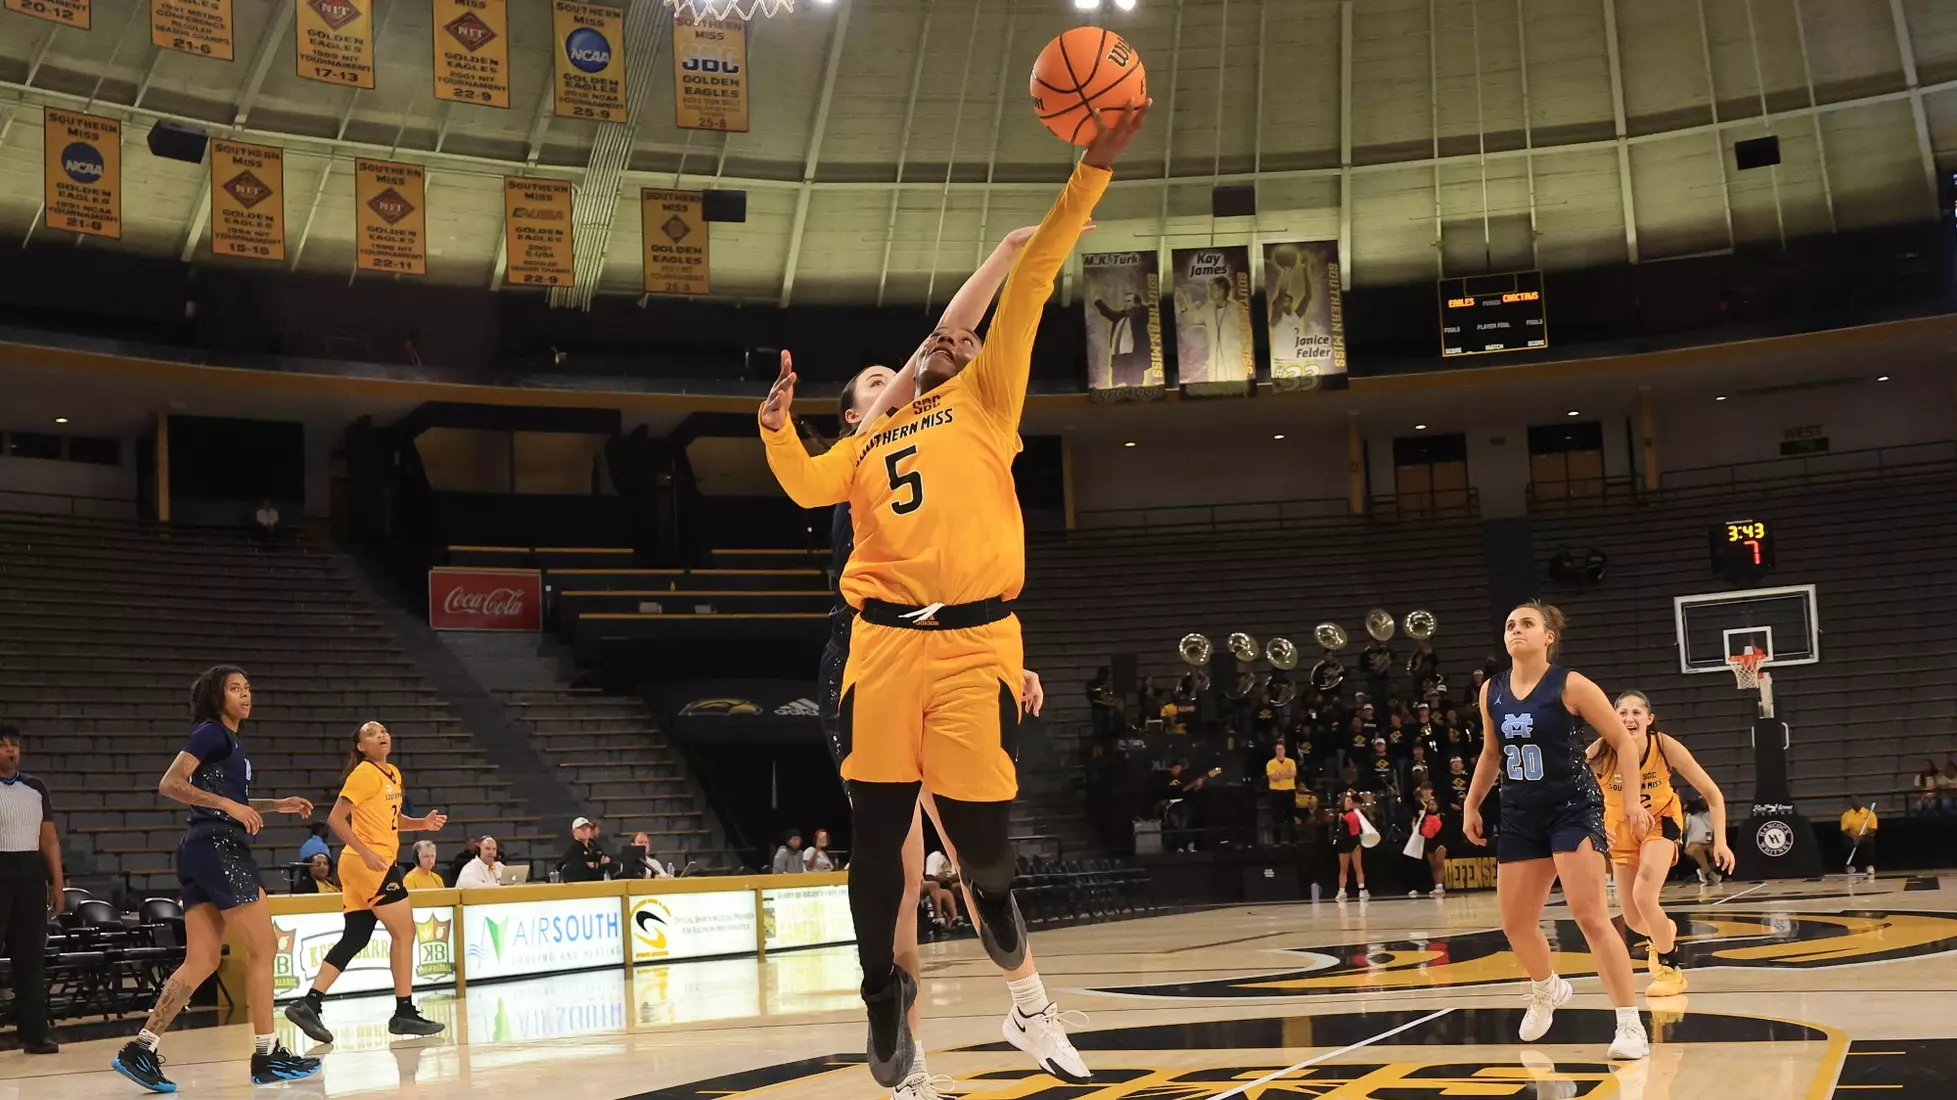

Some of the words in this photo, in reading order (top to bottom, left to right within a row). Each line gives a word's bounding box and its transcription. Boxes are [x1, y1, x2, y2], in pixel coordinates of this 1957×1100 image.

[21, 2, 74, 20] 20-12
[454, 0, 486, 9] MISS
[556, 2, 620, 18] SOUTHERN
[574, 16, 604, 28] MISS
[678, 18, 742, 30] SOUTHERN
[308, 28, 364, 46] GOLDEN
[458, 26, 484, 38] NIT
[695, 30, 724, 40] MISS
[173, 38, 211, 54] 21-6
[309, 38, 362, 52] EAGLES
[444, 52, 498, 66] GOLDEN
[571, 48, 610, 63] NCAA
[300, 54, 371, 72] TOURNAMENT
[447, 61, 498, 73] EAGLES
[314, 67, 358, 82] 17-13
[564, 73, 618, 86] GOLDEN
[682, 74, 740, 87] GOLDEN
[438, 76, 506, 92] TOURNAMENT
[565, 81, 618, 94] EAGLES
[453, 88, 492, 100] 22-9
[592, 93, 618, 102] NCAA
[684, 86, 738, 98] EAGLES
[560, 96, 624, 110] TOURNAMENT
[573, 106, 610, 119] 25-9
[49, 112, 117, 133] SOUTHERN
[67, 127, 99, 140] MISS
[215, 144, 280, 160] SOUTHERN
[66, 160, 102, 175] NCAA
[232, 157, 262, 168] MISS
[360, 162, 422, 177] SOUTHERN
[376, 174, 405, 186] MISS
[508, 180, 568, 192] SOUTHERN
[56, 182, 111, 198] GOLDEN
[524, 192, 552, 201] MISS
[58, 190, 110, 204] EAGLES
[48, 206, 118, 222] TOURNAMENT
[83, 205, 112, 214] NCAA
[662, 203, 688, 212] MISS
[222, 209, 274, 222] GOLDEN
[224, 217, 272, 229] EAGLES
[367, 225, 416, 236] GOLDEN
[516, 226, 564, 236] GOLDEN
[216, 232, 281, 245] TOURNAMENT
[368, 234, 416, 244] EAGLES
[517, 234, 562, 242] EAGLES
[360, 249, 423, 260] TOURNAMENT
[650, 244, 702, 254] GOLDEN
[373, 258, 412, 270] 22-11
[653, 255, 701, 264] EAGLES
[1113, 253, 1140, 265] Turk
[1196, 252, 1220, 266] Kay
[1190, 264, 1228, 278] James
[524, 274, 558, 284] 22-9
[1328, 263, 1344, 333] SOUTHERN
[1448, 298, 1474, 308] EAGLES
[1296, 335, 1330, 348] Janice
[1296, 348, 1332, 358] Felder
[912, 394, 941, 416] SBC
[920, 408, 953, 430] MISS
[885, 444, 924, 515] 5
[1728, 522, 1764, 542] 3:43
[1744, 540, 1760, 564] 7
[1504, 744, 1544, 780] 20
[1648, 780, 1662, 789] MISS
[1760, 822, 1790, 836] HANCOCK
[512, 912, 618, 947] AIRSOUTH
